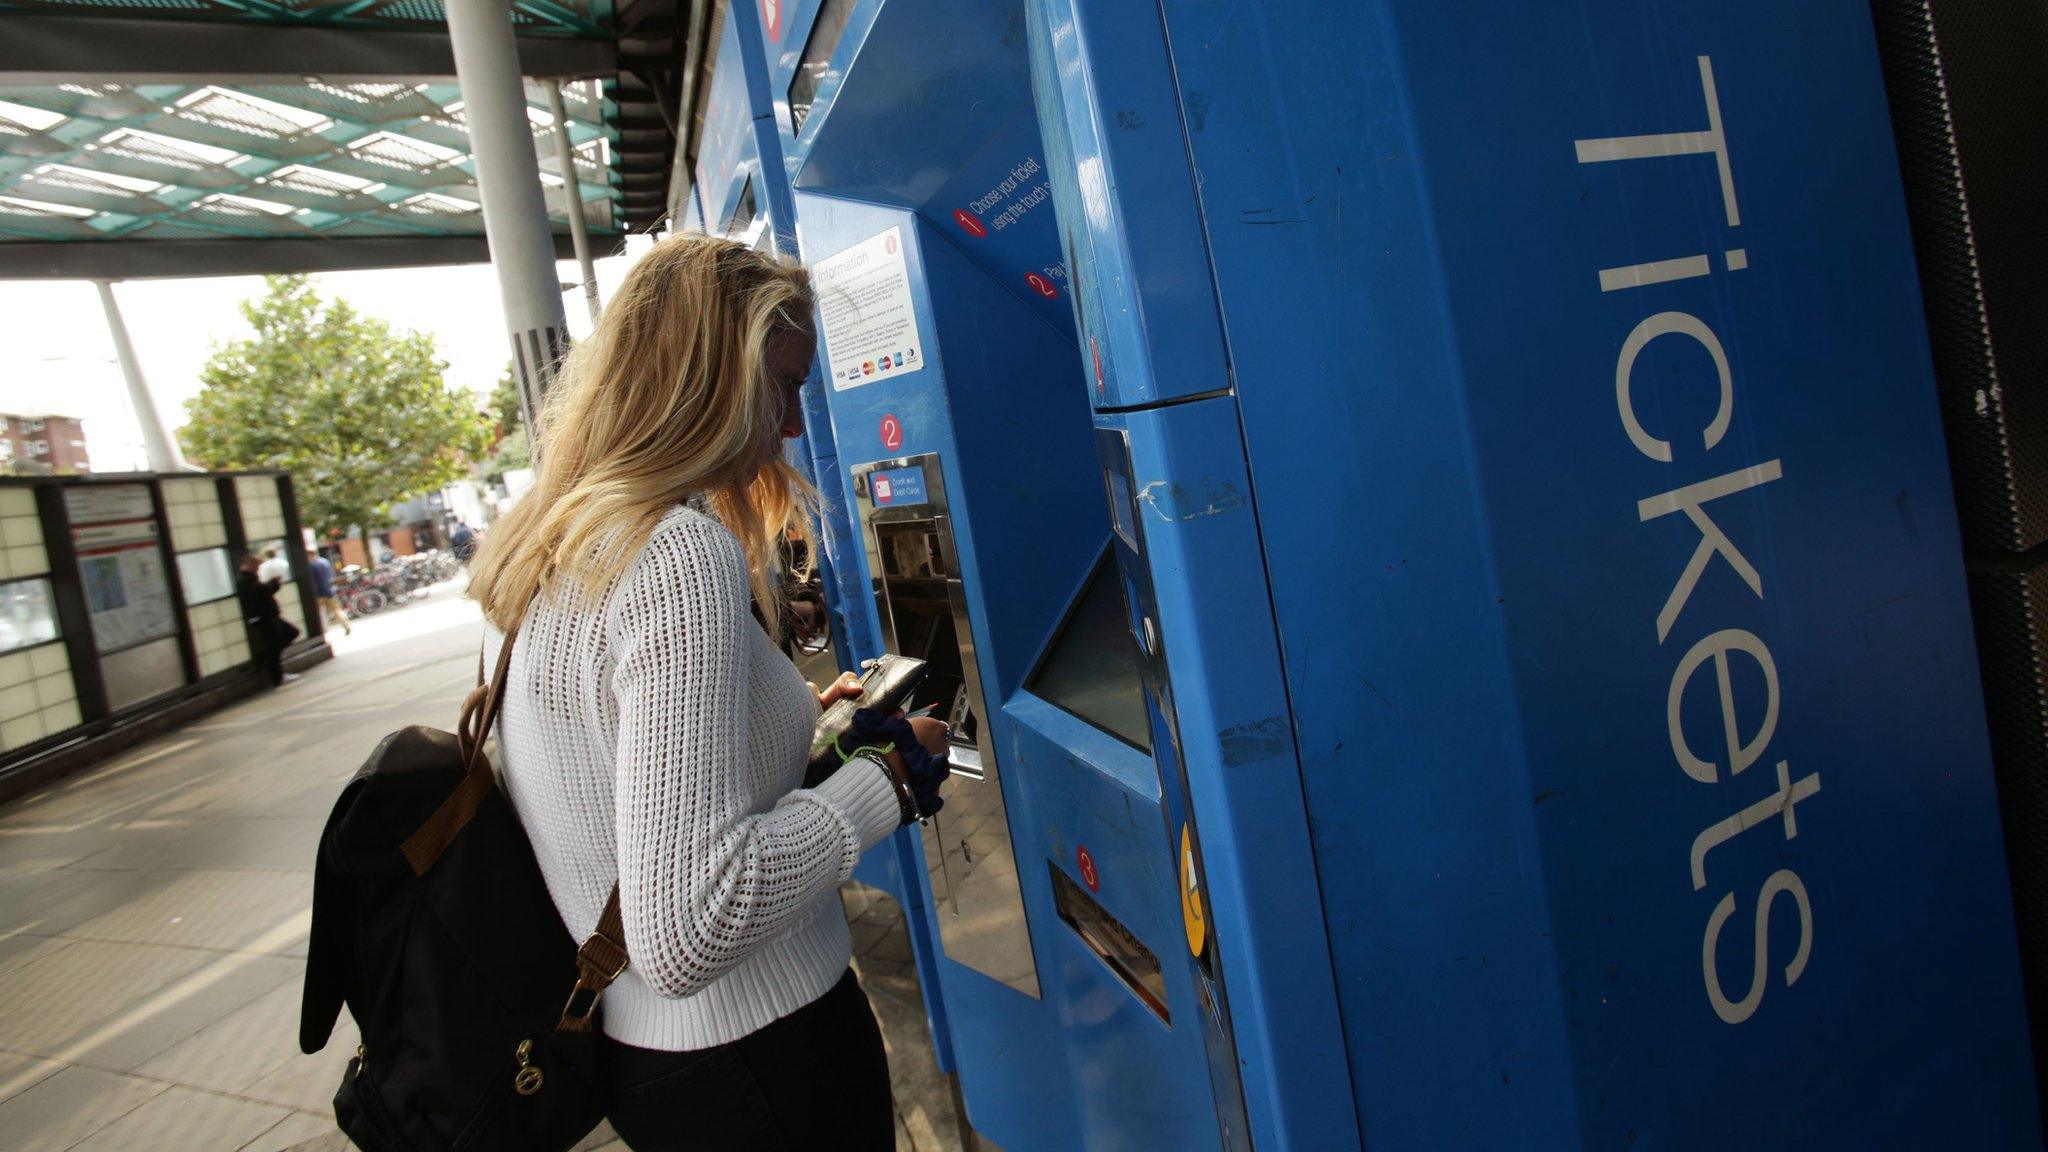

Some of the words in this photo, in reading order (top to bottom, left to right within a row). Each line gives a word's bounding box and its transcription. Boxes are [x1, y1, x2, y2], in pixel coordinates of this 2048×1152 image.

[969, 189, 1003, 215] Choose
[997, 176, 1019, 199] your
[1011, 156, 1042, 183] ticket
[990, 211, 1017, 231] using
[1006, 202, 1027, 218] the
[1019, 185, 1049, 209] touch
[816, 252, 869, 283] Information
[1574, 55, 1821, 1025] Tickets
